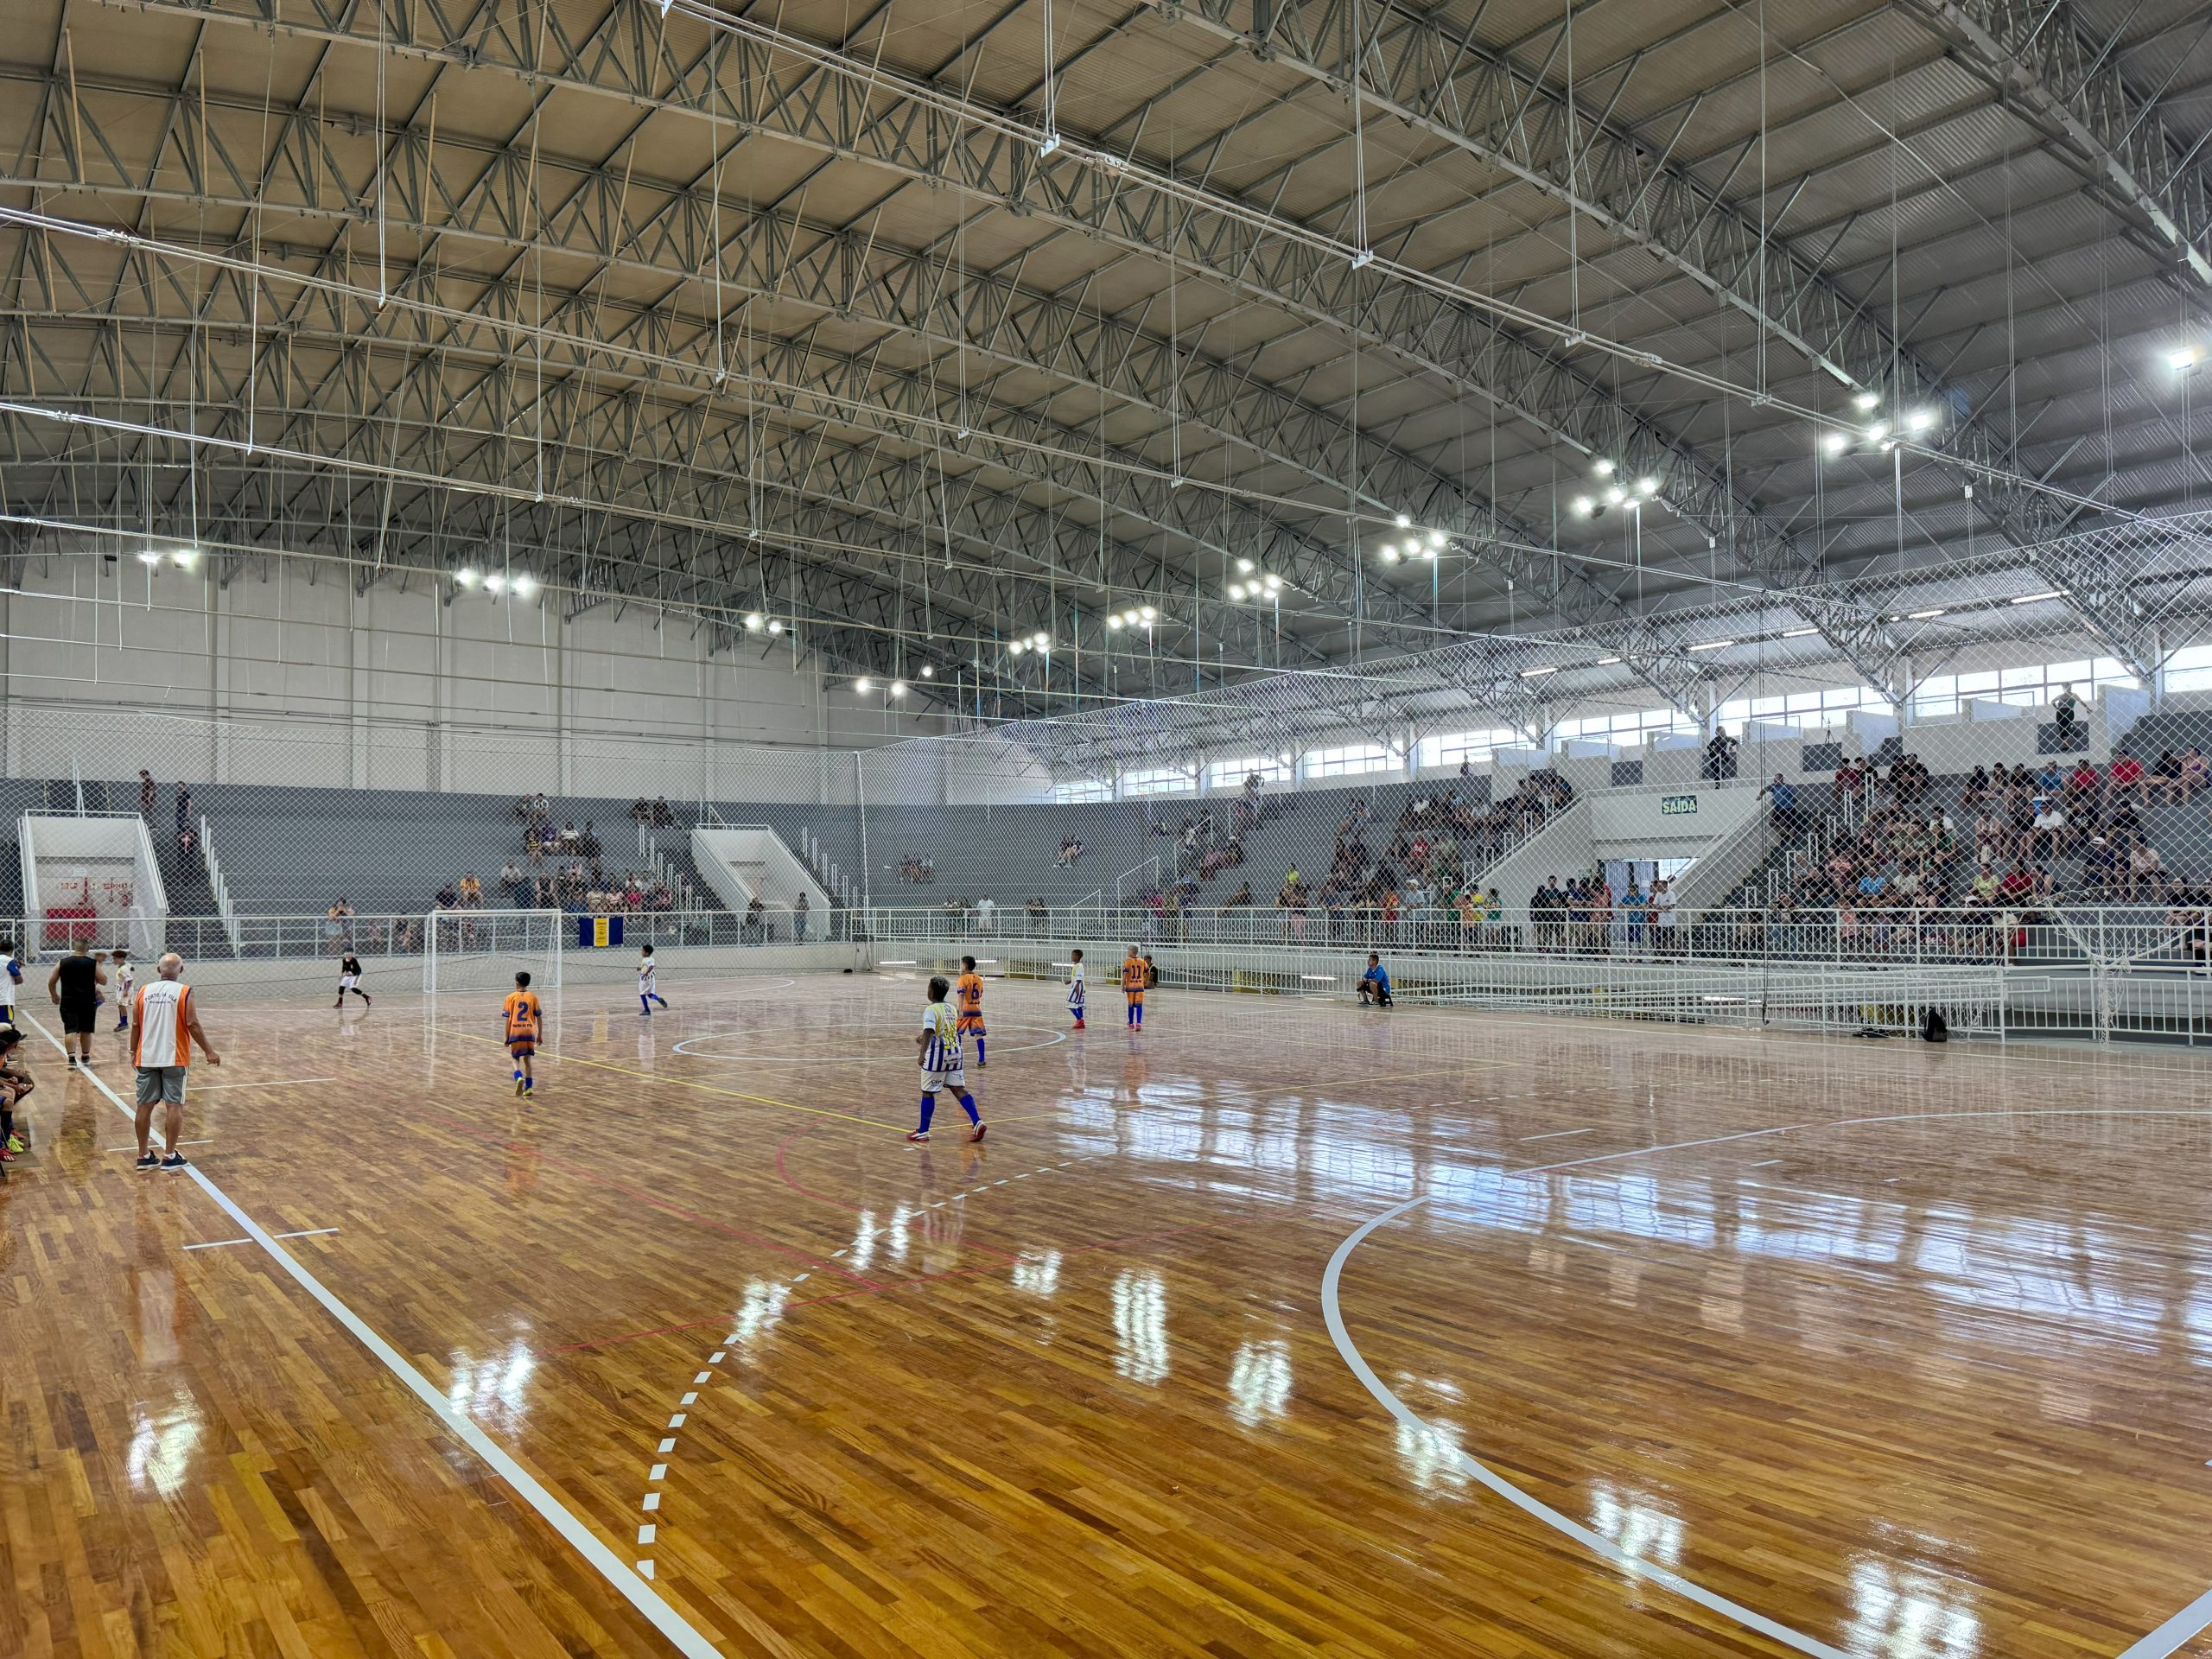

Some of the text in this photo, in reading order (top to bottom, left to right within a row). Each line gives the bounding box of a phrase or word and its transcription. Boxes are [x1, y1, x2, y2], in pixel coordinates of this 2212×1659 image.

[1662, 798, 1696, 813] SAÍDA
[1131, 964, 1141, 979] 11
[971, 982, 980, 1000] 6
[517, 1001, 529, 1021] 2
